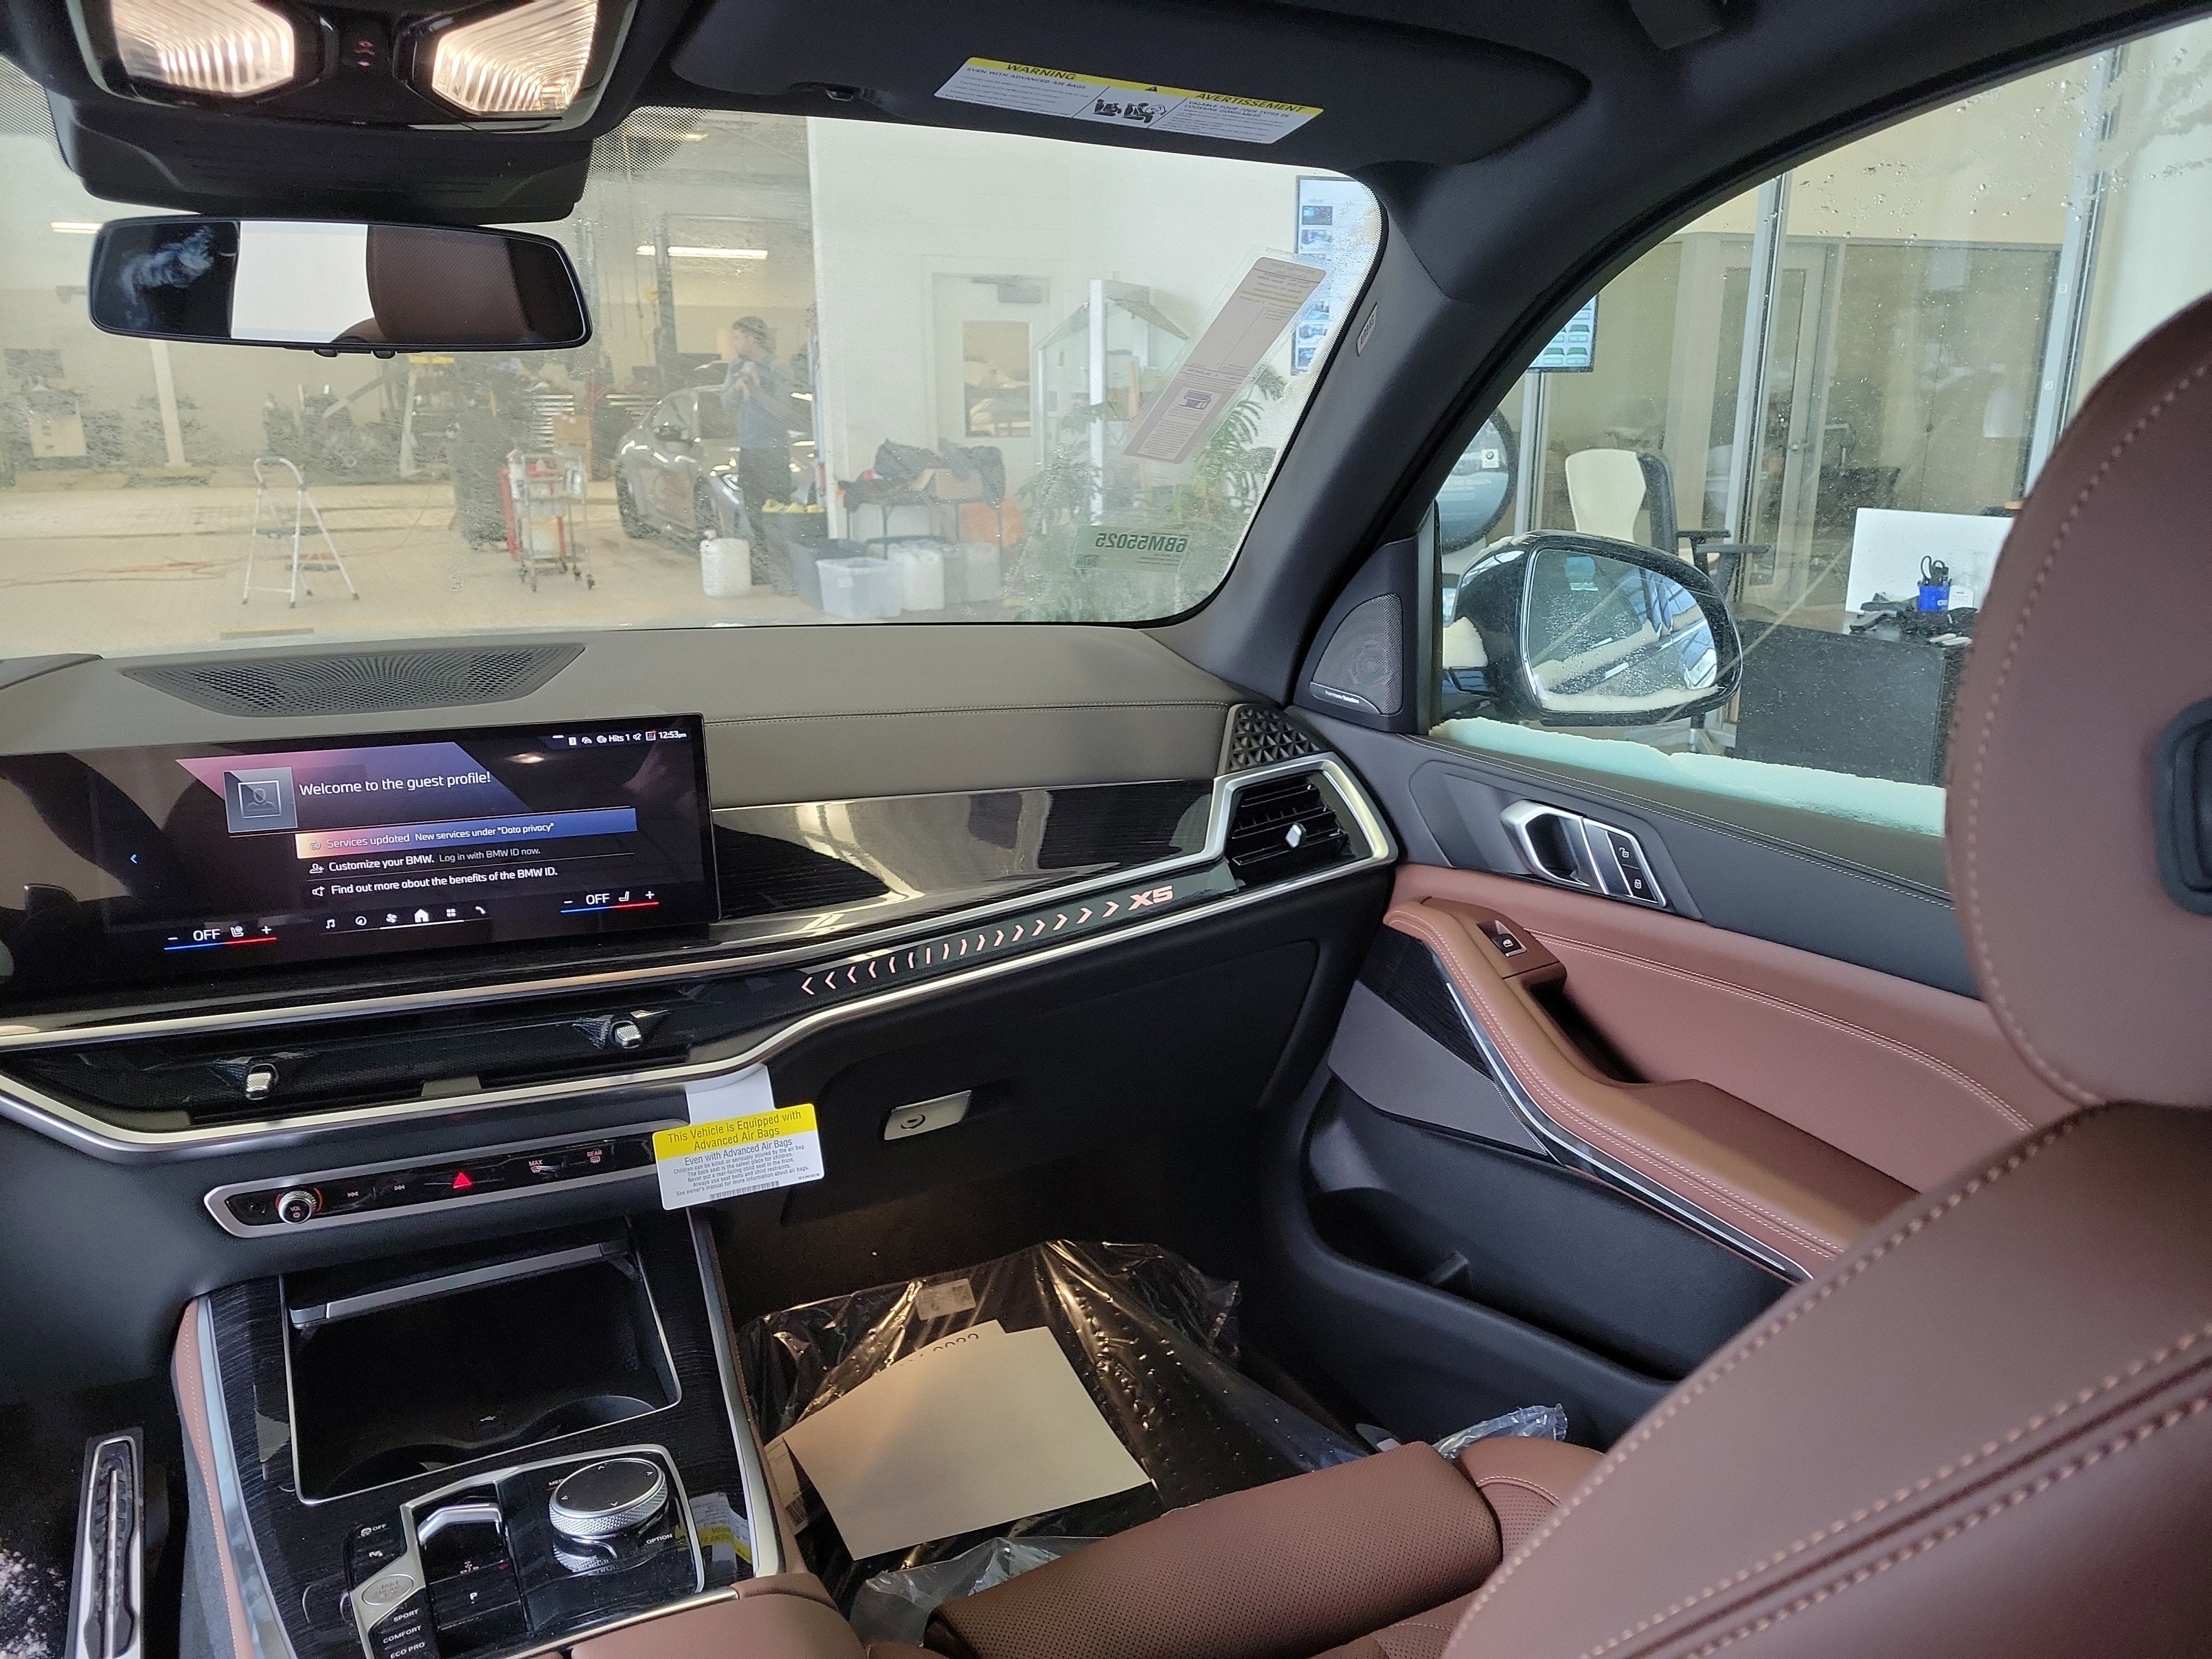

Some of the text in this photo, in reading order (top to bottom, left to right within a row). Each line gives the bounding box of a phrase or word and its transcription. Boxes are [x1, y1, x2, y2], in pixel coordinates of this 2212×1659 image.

[1007, 64, 1076, 80] WARNING
[1011, 74, 1049, 83] ADVANCED
[1195, 93, 1305, 112] AVERTISSEMENT
[658, 730, 687, 740] 12:53pm
[299, 771, 490, 795] Welcome to the guest profile!
[327, 838, 368, 849] Services
[370, 833, 410, 847] updated
[415, 832, 434, 841] New
[436, 830, 470, 840] services
[472, 828, 496, 837] under
[329, 854, 435, 871] Customize your BMW.
[439, 854, 455, 863] Log
[466, 851, 484, 860] with
[486, 849, 509, 859] BMW
[331, 866, 558, 894] Find out more about the benefits of the BMW ID.
[586, 893, 610, 905] OFF
[1128, 885, 1173, 911] X5
[193, 929, 221, 941] OFF
[667, 1110, 801, 1143] This Vehicle is Equipped with
[694, 1126, 779, 1150] Advanced Air Bags
[685, 1139, 792, 1165] Even with Advanced Air Bags
[732, 1154, 753, 1163] seriously
[755, 1152, 771, 1160] injured
[716, 1168, 742, 1177] rear-facing
[746, 1172, 774, 1181] information
[646, 1533, 673, 1544] OPTION
[393, 1608, 419, 1622] SPORT
[383, 1625, 421, 1644] COMFORT
[390, 1642, 425, 1659] ECO PRO
